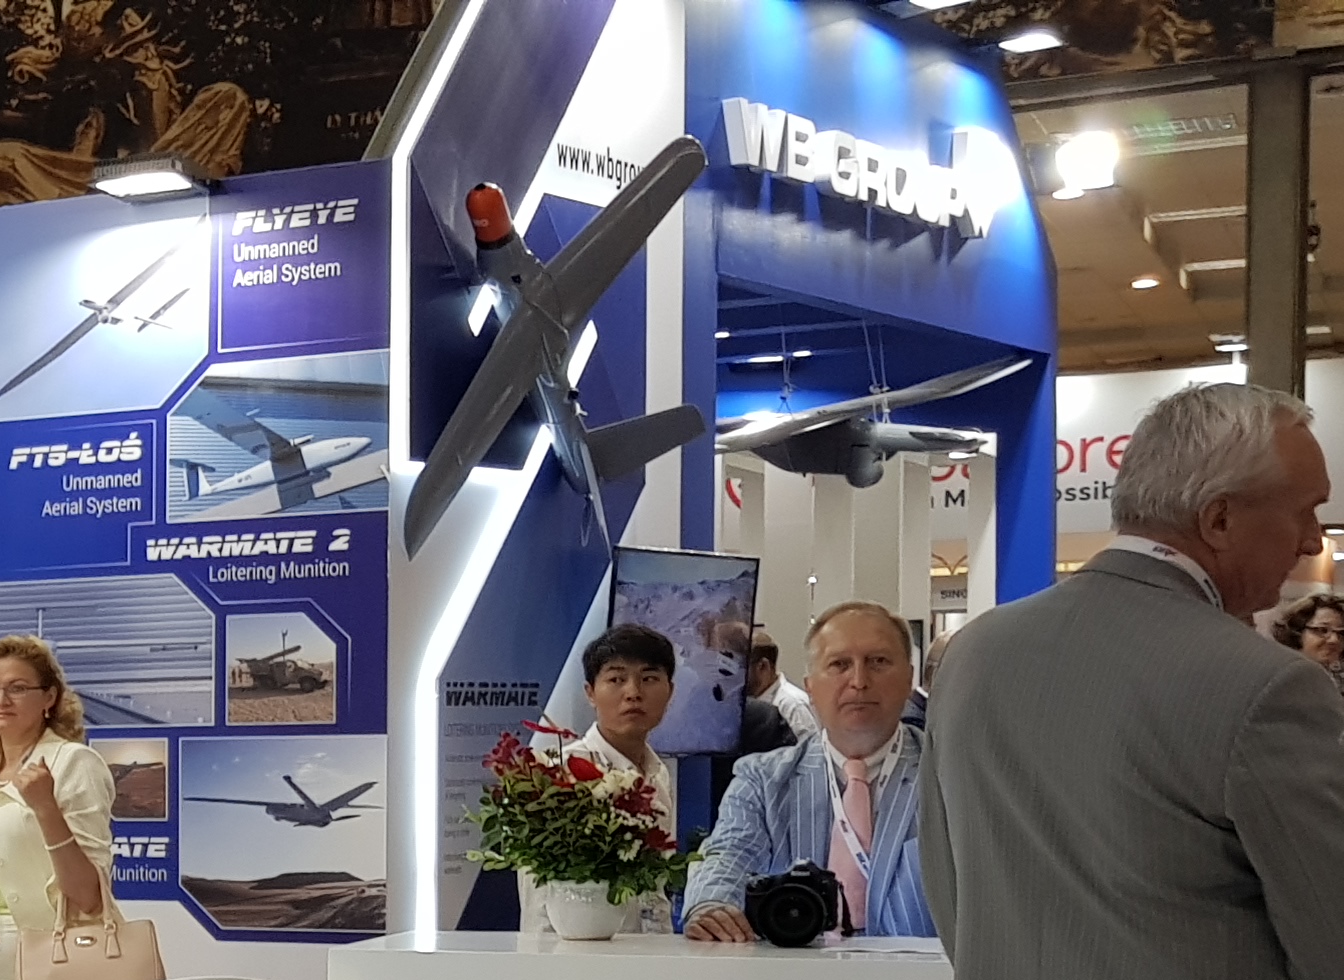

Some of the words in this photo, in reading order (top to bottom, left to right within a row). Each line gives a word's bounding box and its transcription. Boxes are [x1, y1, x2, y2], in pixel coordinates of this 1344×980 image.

[231, 198, 359, 237] FLYEYE
[233, 233, 319, 263] Unmanned
[232, 263, 278, 288] Aerial
[281, 261, 342, 286] System
[62, 468, 142, 492] Unmanned
[41, 498, 83, 518] Aerial
[86, 495, 142, 519] System
[145, 530, 317, 562] WARMATE
[328, 528, 352, 552] 2
[208, 561, 277, 585] Loitering
[280, 557, 350, 581] Munition
